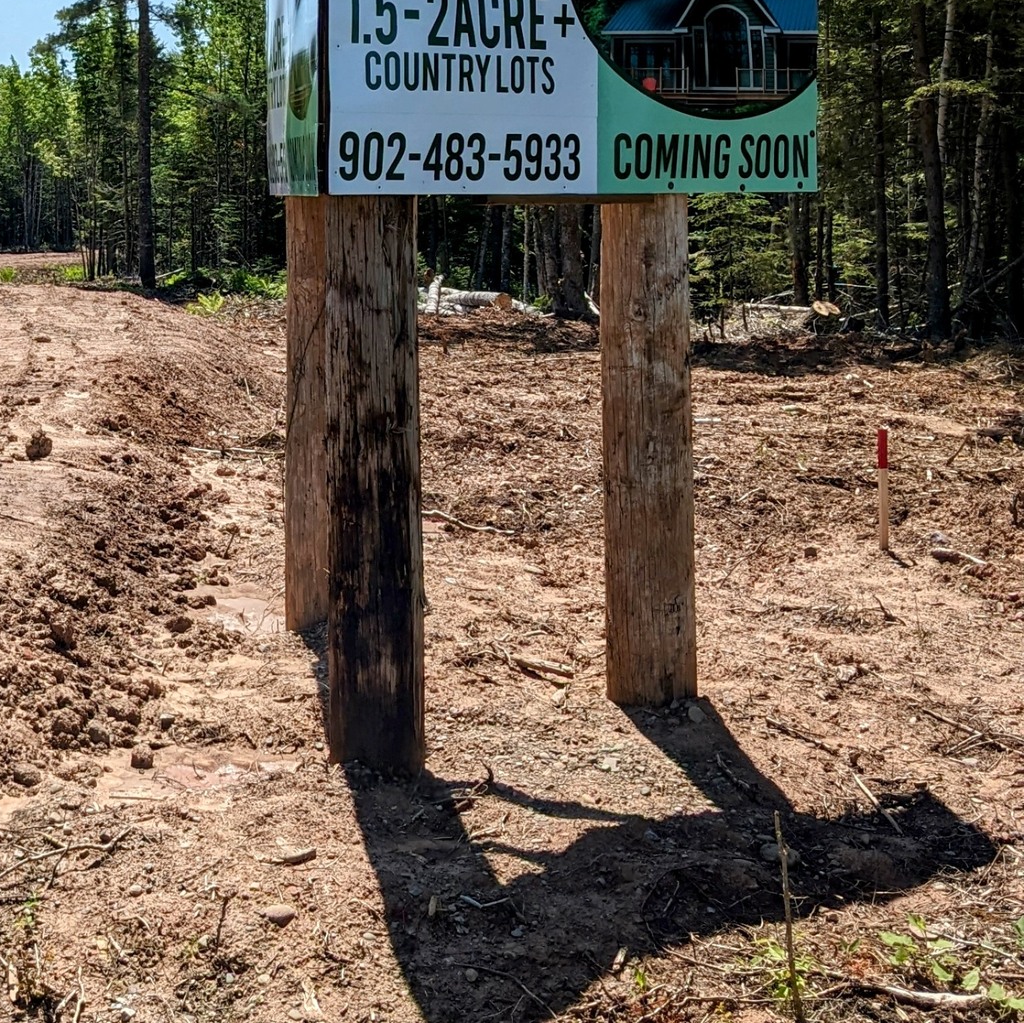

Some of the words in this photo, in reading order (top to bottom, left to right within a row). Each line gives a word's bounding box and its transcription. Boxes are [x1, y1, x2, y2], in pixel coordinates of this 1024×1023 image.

[338, 130, 581, 181] 902-483-5933
[613, 132, 732, 180] COMING
[738, 133, 809, 179] SOON
